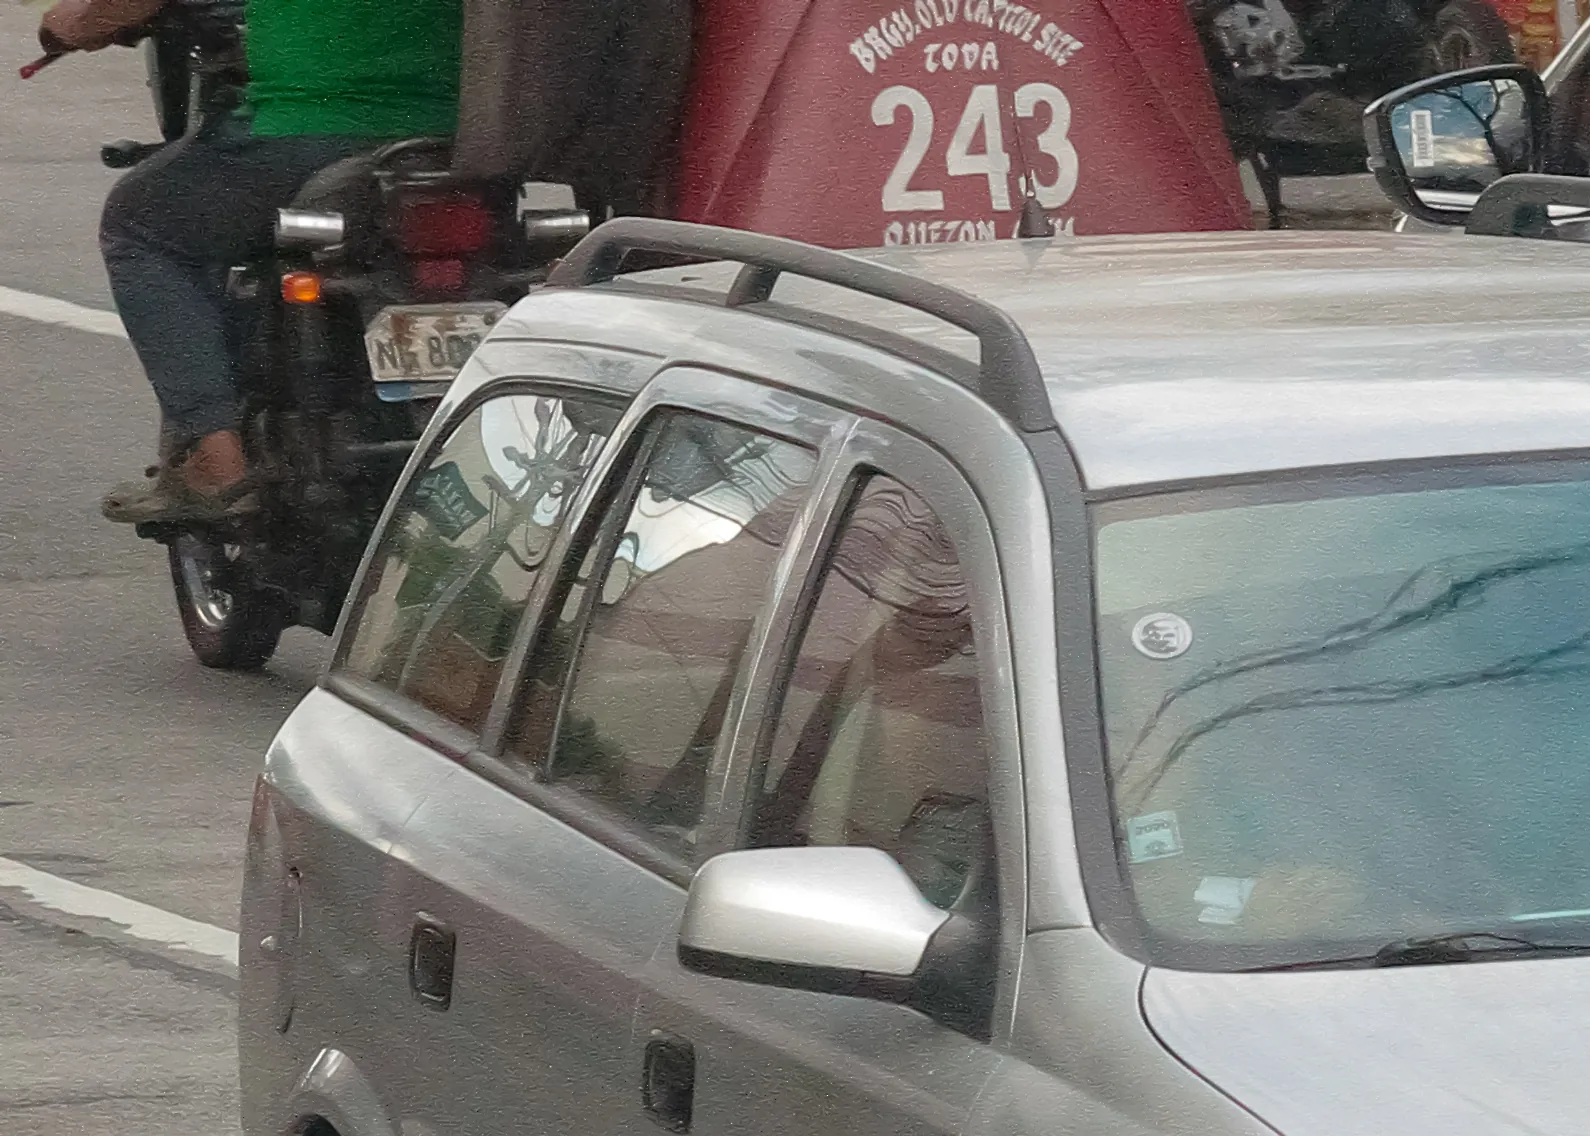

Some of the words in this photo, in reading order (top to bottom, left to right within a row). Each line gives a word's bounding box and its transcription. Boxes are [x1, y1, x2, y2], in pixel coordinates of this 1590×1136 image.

[923, 41, 999, 73] TODA
[1032, 22, 1084, 66] SITE
[871, 82, 1079, 211] 243
